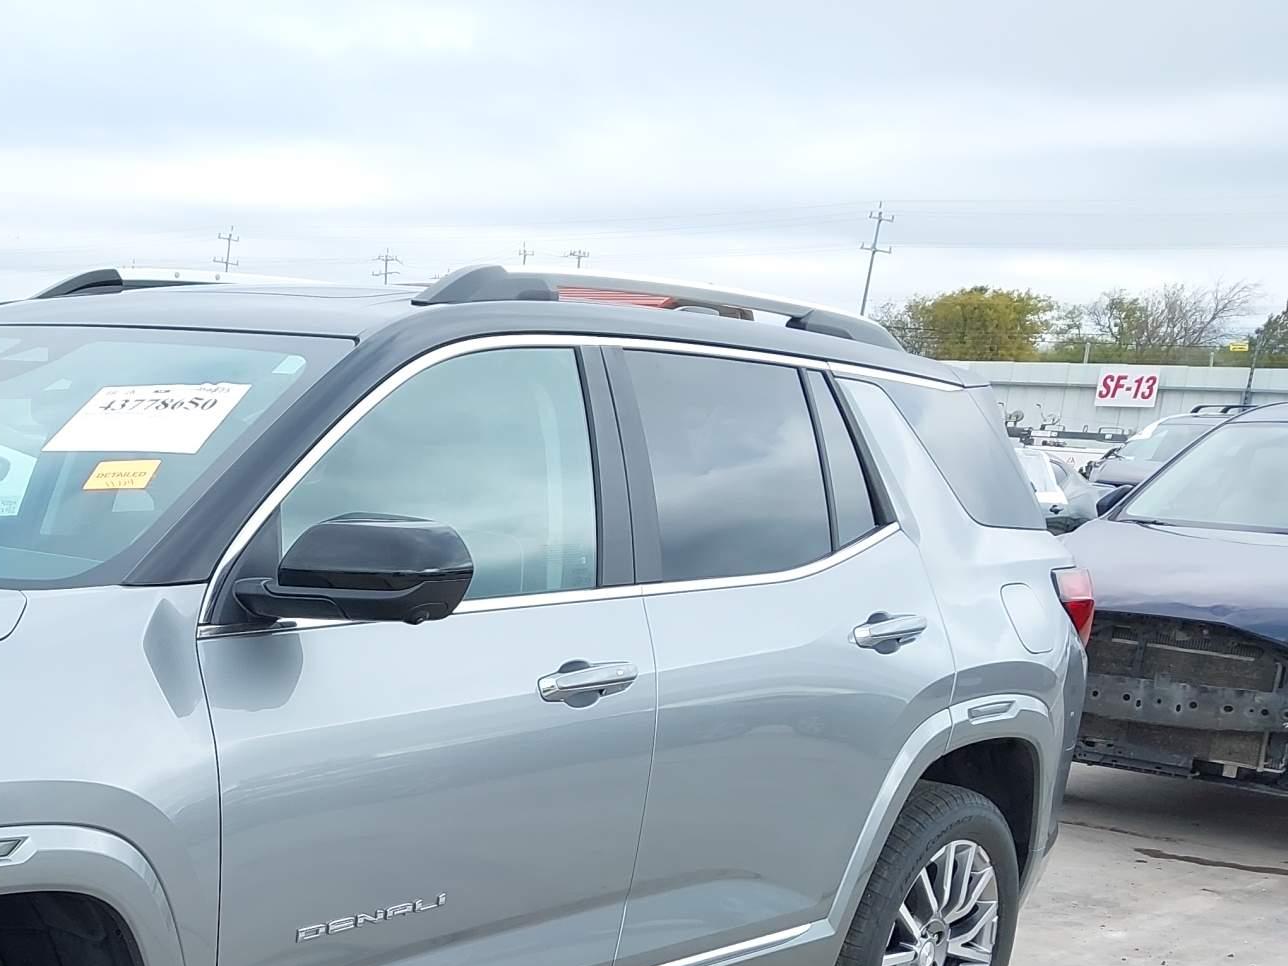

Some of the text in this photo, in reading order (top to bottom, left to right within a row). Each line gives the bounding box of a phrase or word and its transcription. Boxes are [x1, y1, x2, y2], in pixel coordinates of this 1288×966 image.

[1098, 374, 1158, 400] SF-13
[98, 396, 219, 412] 43778650
[295, 892, 448, 944] DENALI
